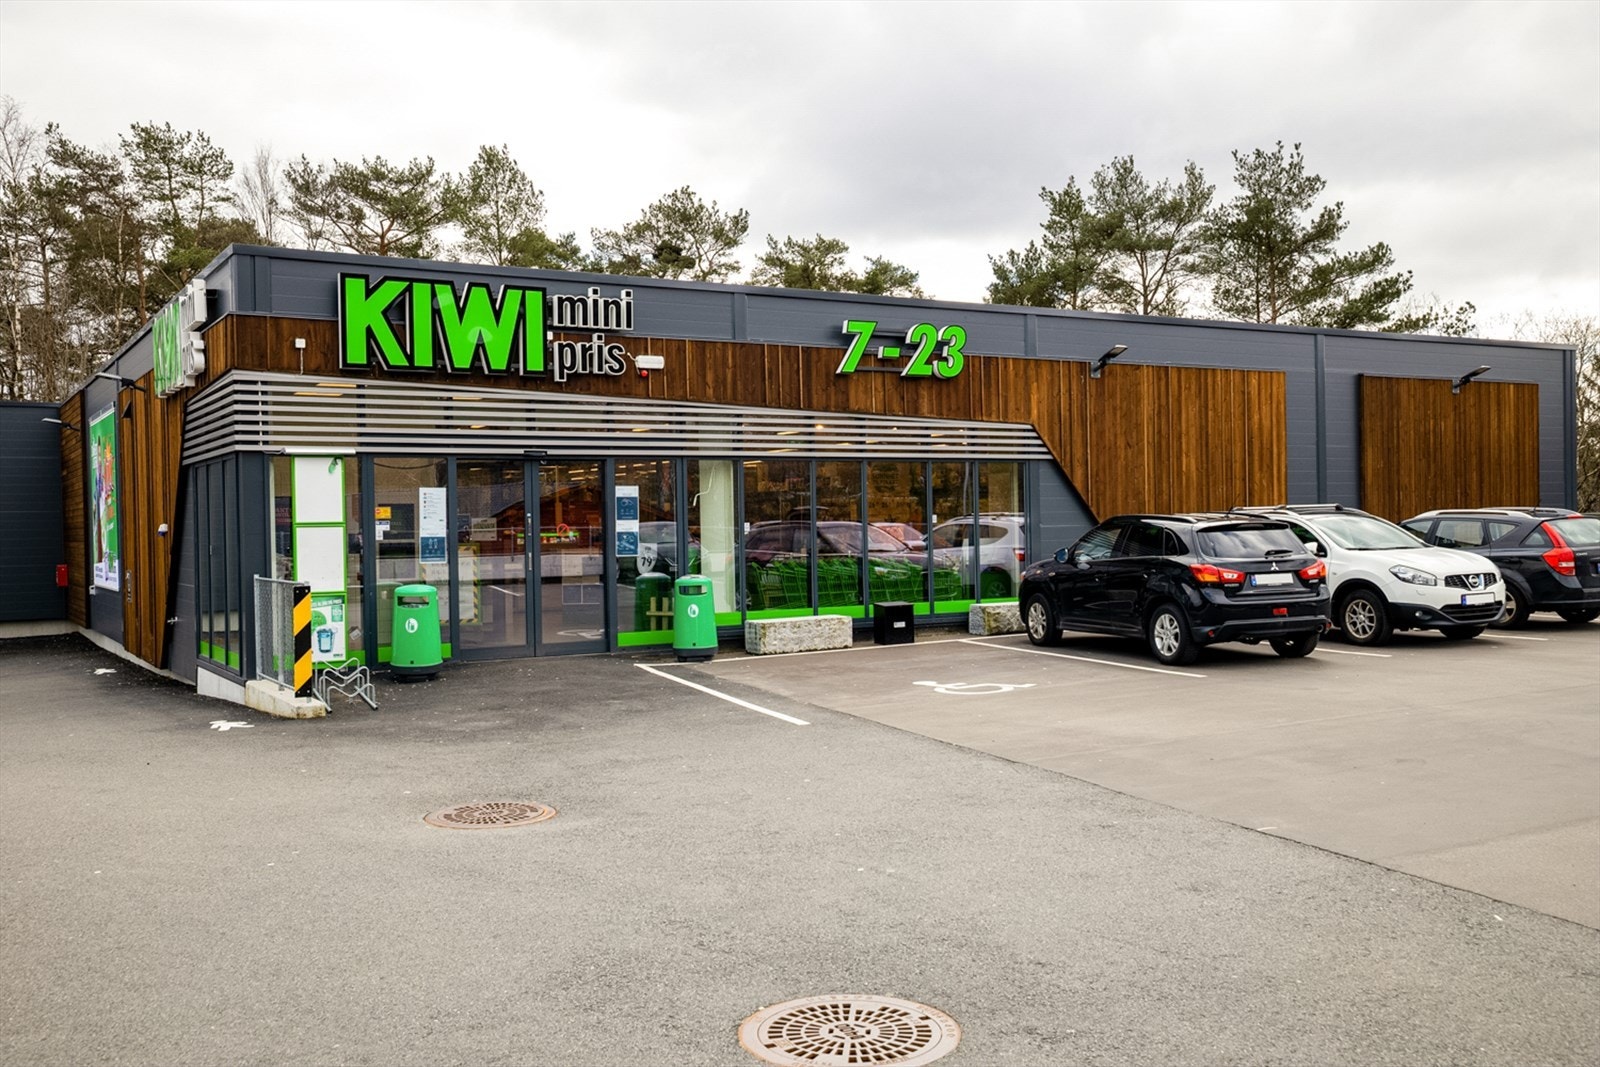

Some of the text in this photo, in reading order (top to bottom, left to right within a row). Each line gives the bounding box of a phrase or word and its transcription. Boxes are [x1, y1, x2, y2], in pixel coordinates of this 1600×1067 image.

[337, 272, 547, 377] KIWI
[553, 286, 634, 331] mini
[553, 332, 627, 382] pris
